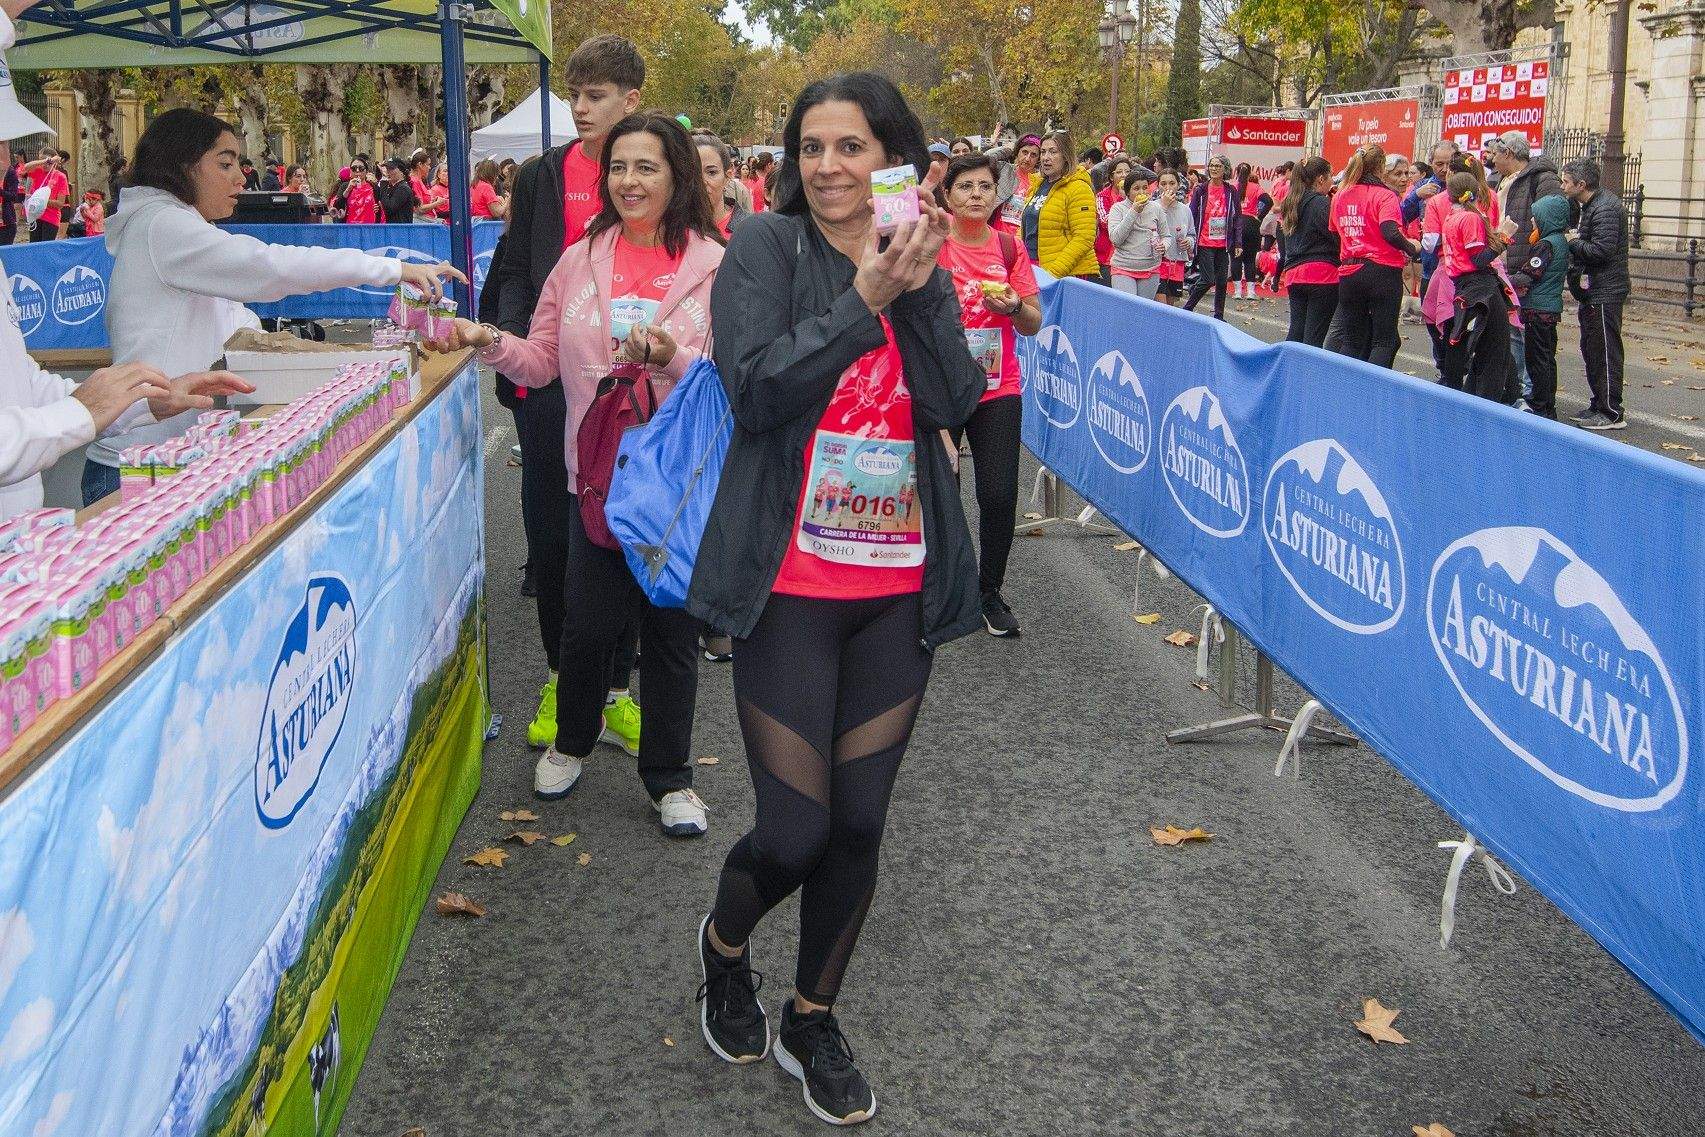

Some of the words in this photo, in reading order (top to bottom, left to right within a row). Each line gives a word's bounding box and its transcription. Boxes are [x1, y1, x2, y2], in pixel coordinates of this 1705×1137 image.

[1366, 117, 1379, 133] pelo
[1445, 111, 1483, 132] ¡OBJETIVO
[1484, 108, 1542, 126] CONSEGUIDO!
[1242, 129, 1300, 141] Santander
[1368, 132, 1388, 143] tesoro
[1347, 205, 1357, 215] TU
[1339, 216, 1366, 226] DORSAL
[1090, 382, 1145, 456] ASTURIANA
[1295, 486, 1335, 520] CENTRAL
[1339, 509, 1389, 549] LECHERA
[820, 528, 848, 538] CARRERA
[849, 531, 857, 539] DE
[858, 521, 881, 531] 6796
[812, 540, 855, 556] OYSHO
[1270, 482, 1393, 611] ASTURIANA
[879, 551, 911, 559] Santander
[1477, 582, 1551, 639] CENTRAL
[1562, 627, 1651, 698] LECHERA
[1441, 574, 1658, 786] ASTURIANA
[264, 643, 351, 805] ASTURIANA
